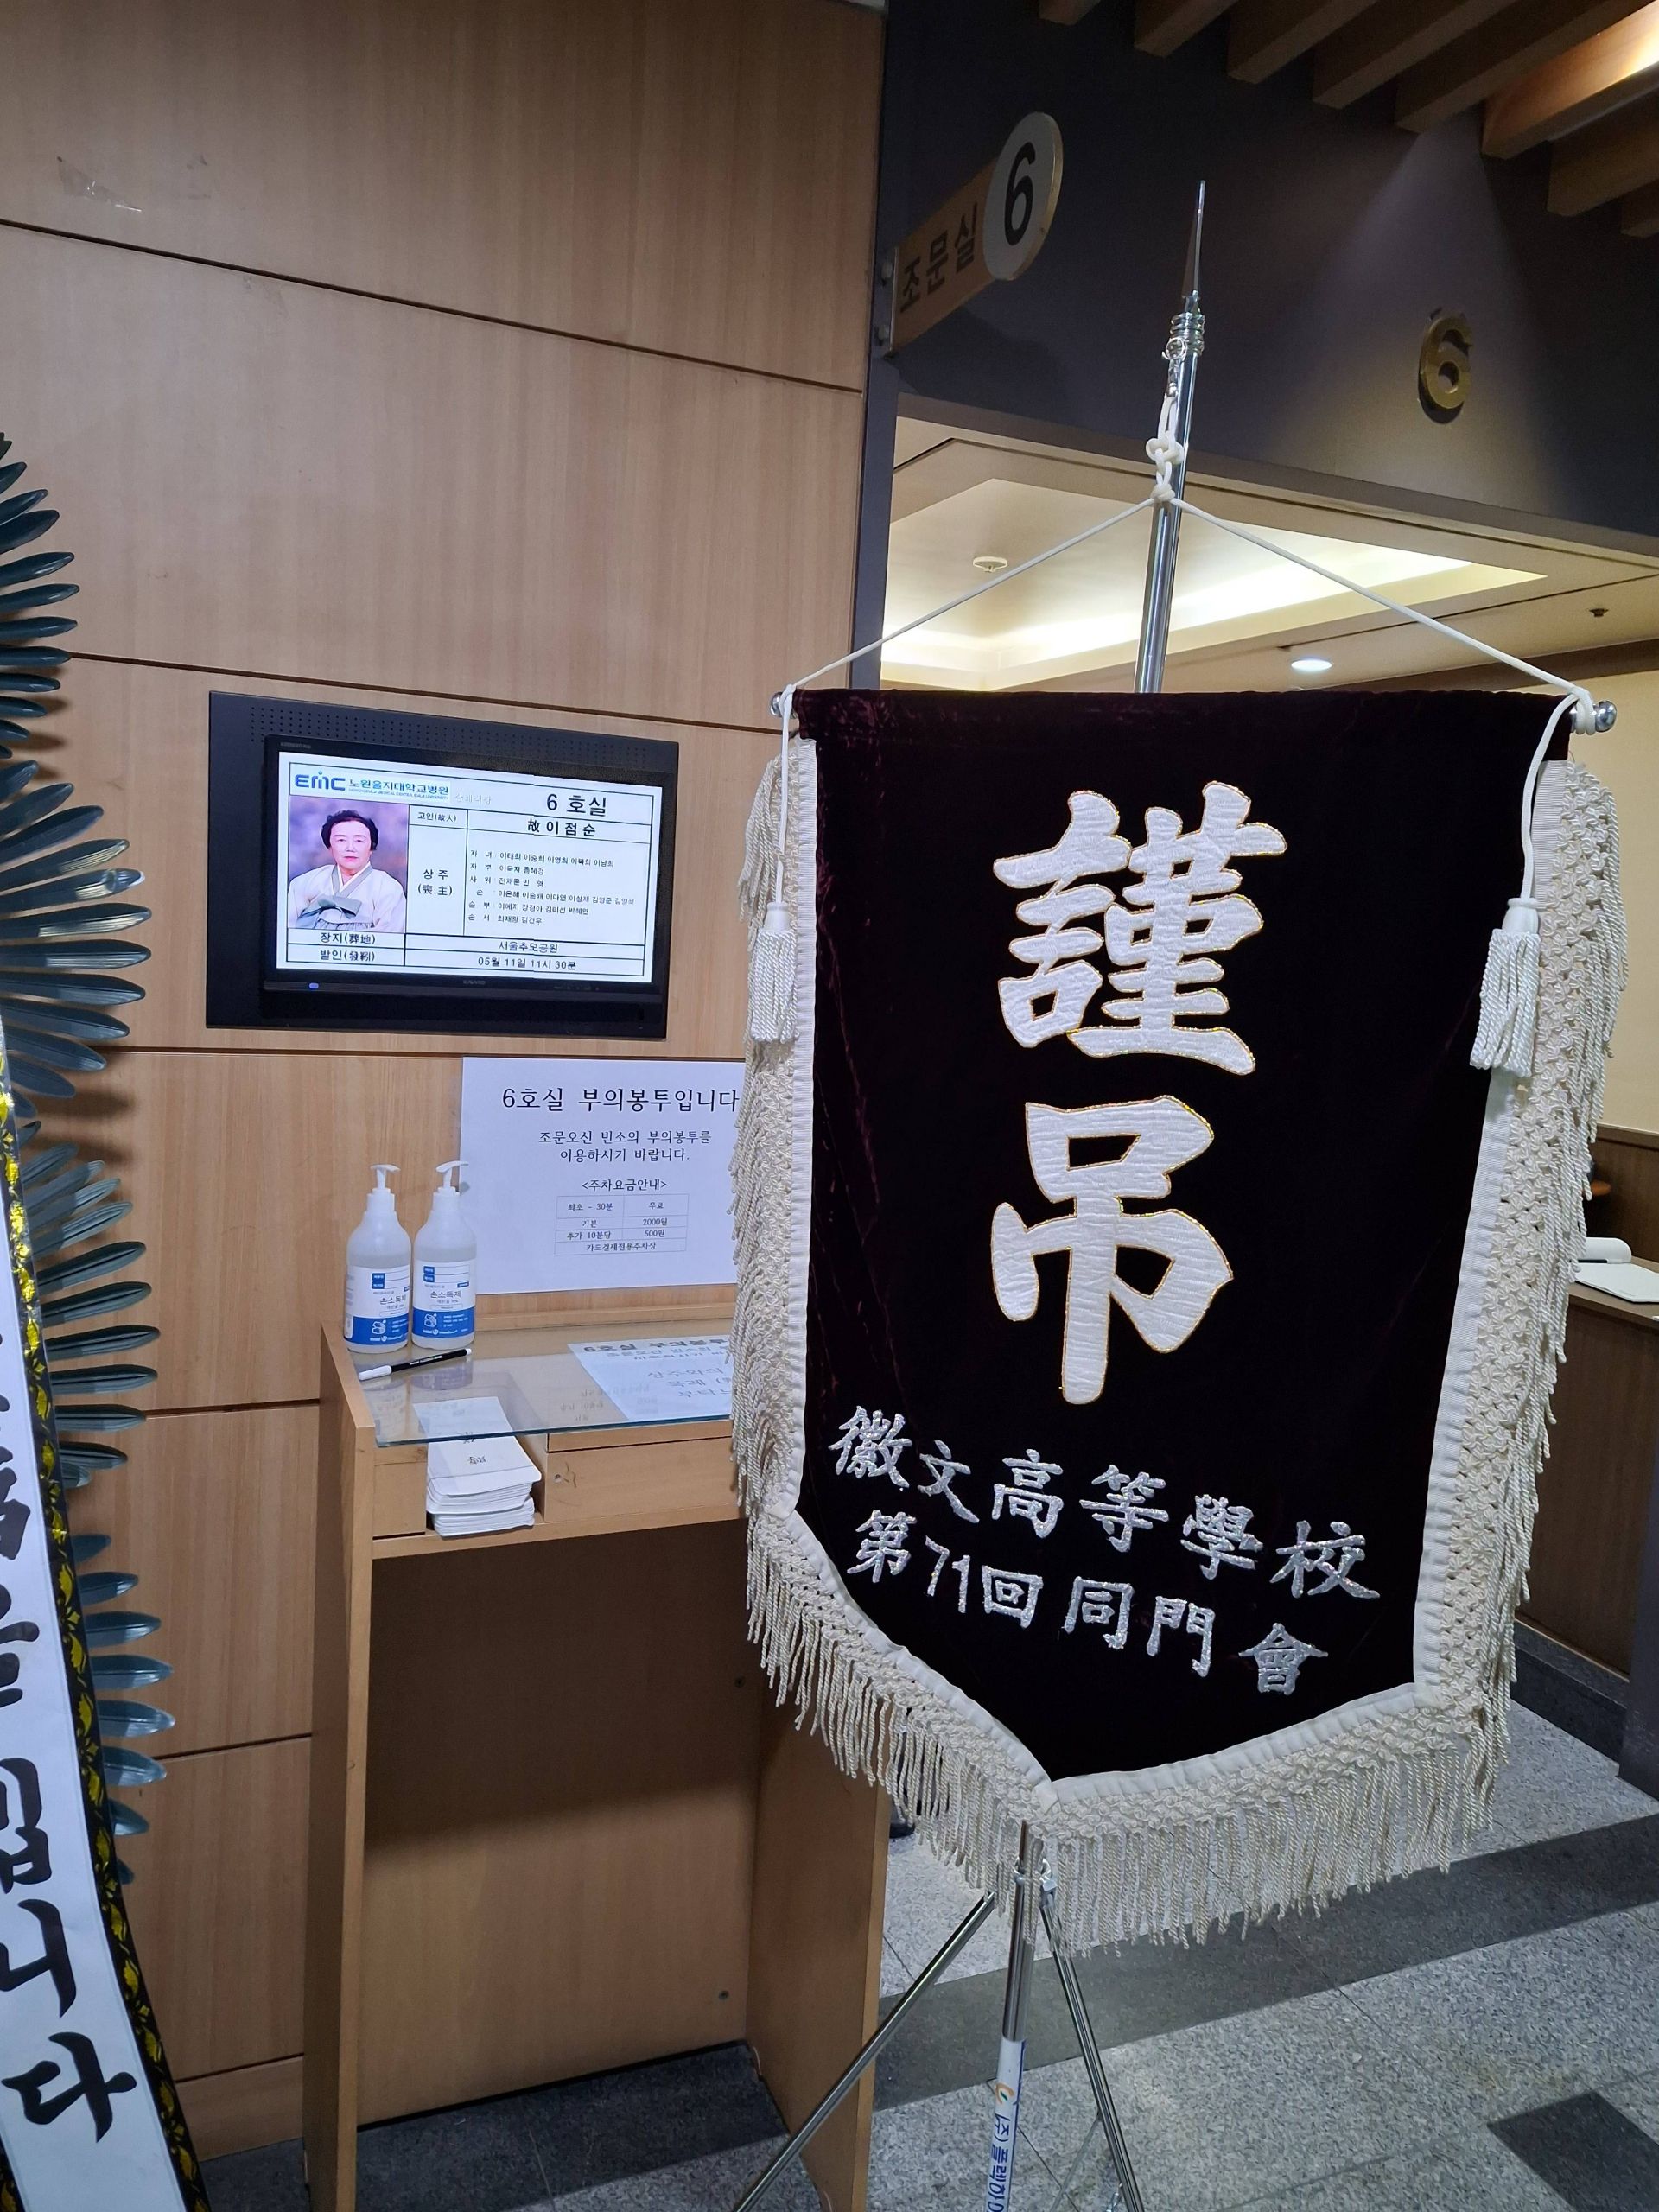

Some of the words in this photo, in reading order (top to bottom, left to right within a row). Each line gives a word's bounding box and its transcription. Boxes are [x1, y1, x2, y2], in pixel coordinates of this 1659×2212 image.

[899, 202, 978, 314] 조문실
[1004, 141, 1036, 246] 6
[1420, 315, 1473, 410] 6
[295, 771, 346, 791] EMC
[348, 779, 449, 796] 노원을지대학교병원
[546, 793, 558, 810] 6
[566, 795, 607, 817] 호실
[498, 941, 558, 954] 서울추모공원
[478, 956, 500, 968] 05월
[505, 957, 526, 969] 11일
[531, 958, 551, 970] 11시
[555, 959, 576, 971] 30분
[502, 1087, 563, 1112] 6호실
[578, 1088, 741, 1113] 부의봉투입니다
[992, 781, 1287, 1404] 謹吊
[538, 1130, 593, 1144] 조문오신
[601, 1130, 639, 1144] 빈소의
[647, 1129, 712, 1144] 부의봉투를
[560, 1148, 626, 1163] 이용하시기
[634, 1148, 690, 1162] 바랍니다.
[582, 1179, 667, 1192] <주차요금안내>
[596, 1202, 613, 1211] 30분
[642, 1217, 668, 1227] 2000원
[644, 1229, 665, 1238] 500원
[430, 1290, 461, 1299] 손소독제
